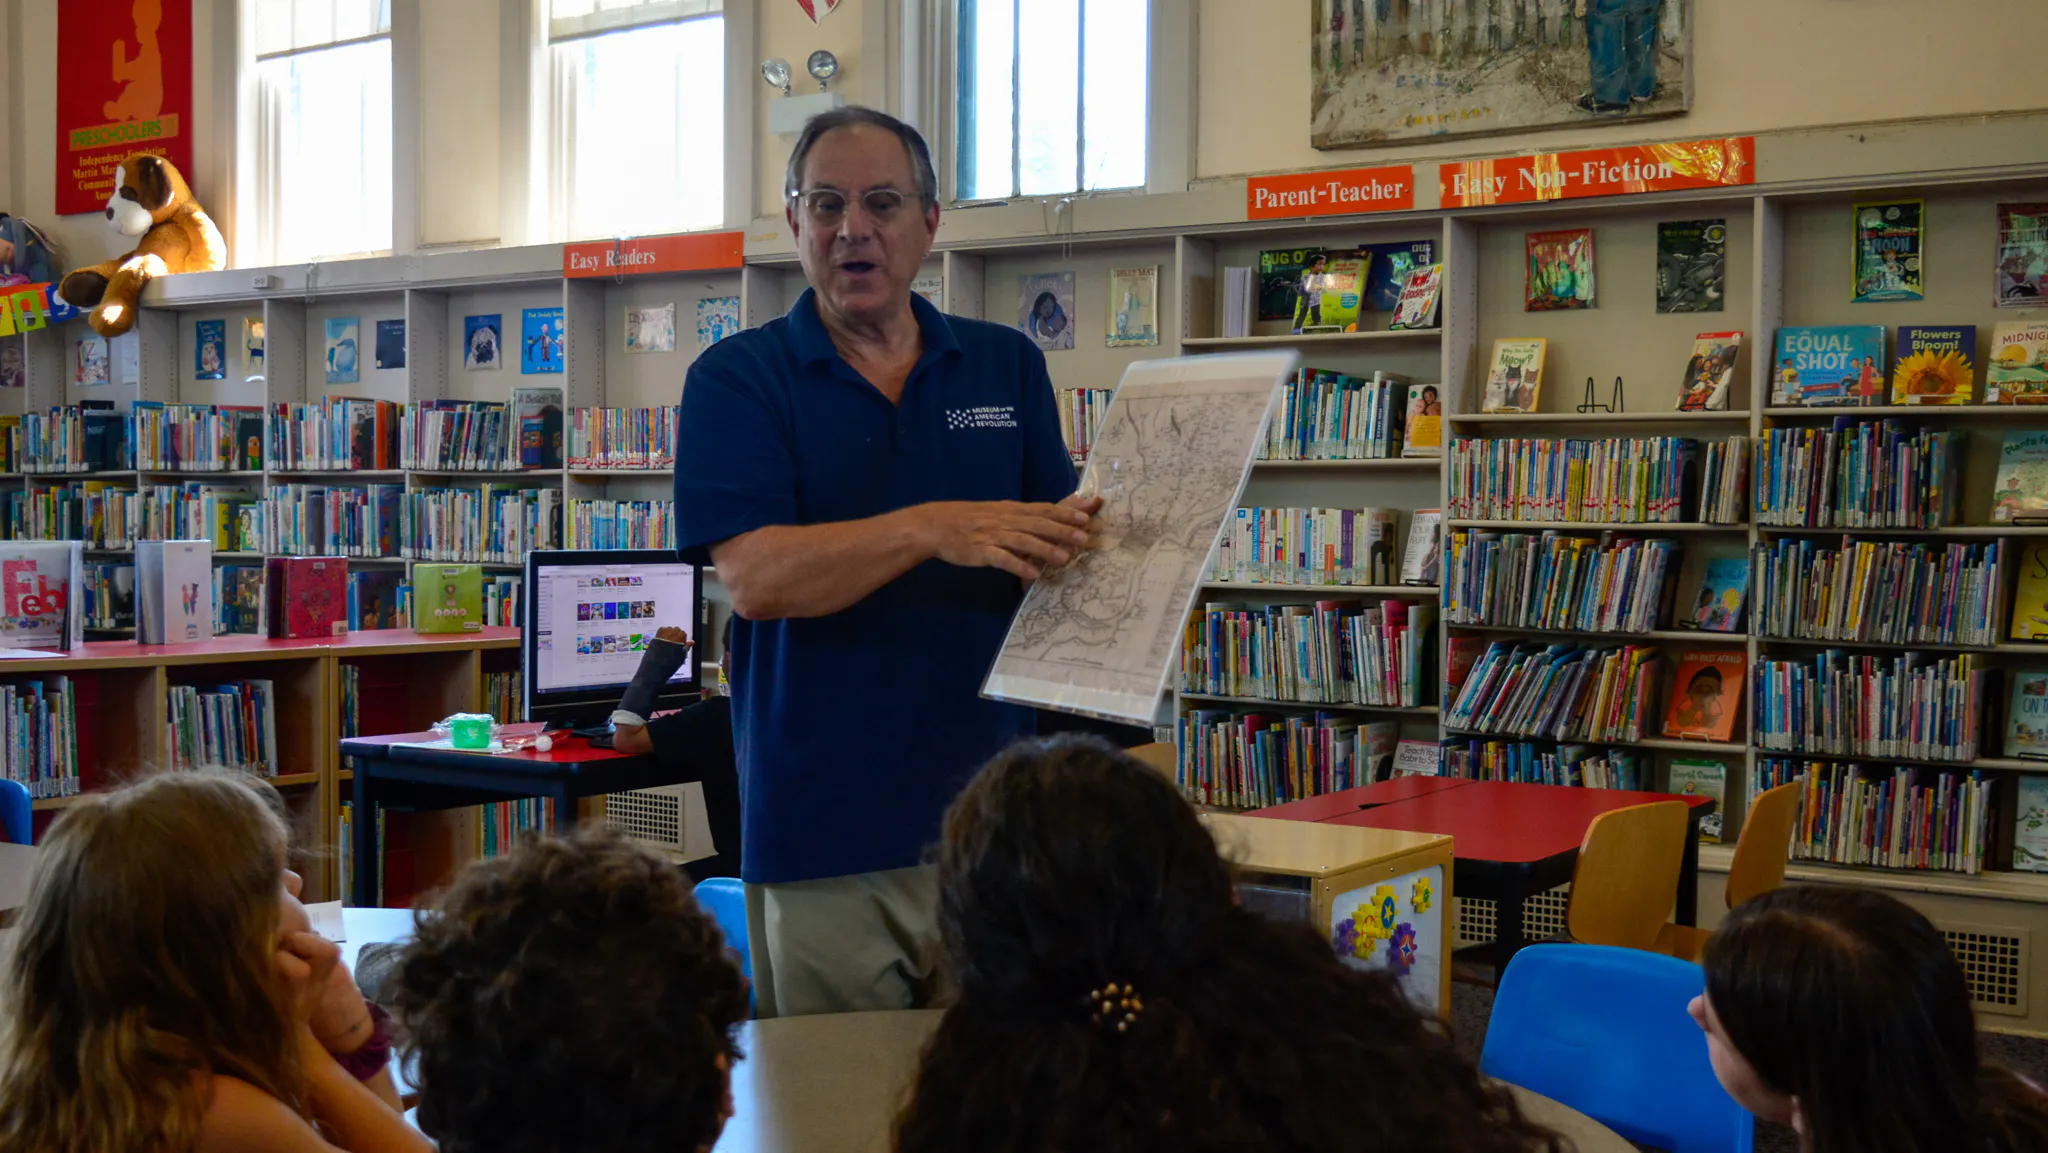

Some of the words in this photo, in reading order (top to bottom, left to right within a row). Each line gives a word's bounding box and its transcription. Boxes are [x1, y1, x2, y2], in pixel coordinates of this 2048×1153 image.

[73, 120, 162, 148] PRESCHOOLERS
[73, 168, 98, 179] Martin
[1452, 173, 1507, 197] Easy
[1518, 158, 1673, 190] Non-Fiction
[79, 177, 115, 191] Communit
[1255, 178, 1403, 209] Parent-Teacher
[570, 251, 600, 271] Easy
[606, 249, 656, 268] Readers
[1262, 252, 1289, 266] BUG
[1910, 329, 1961, 339] Flowers
[1785, 334, 1854, 353] EQUAL
[1912, 341, 1959, 350] Bloom!
[1500, 353, 1534, 367] Meow?
[1795, 352, 1849, 370] SHOT
[975, 413, 1010, 421] AMERICAN
[976, 420, 1018, 428] REVOLUTION
[2004, 438, 2037, 456] Plants
[2022, 697, 2040, 714] ON
[1404, 745, 1425, 756] Teach
[1400, 753, 1417, 763] Baby
[1418, 755, 1426, 763] to
